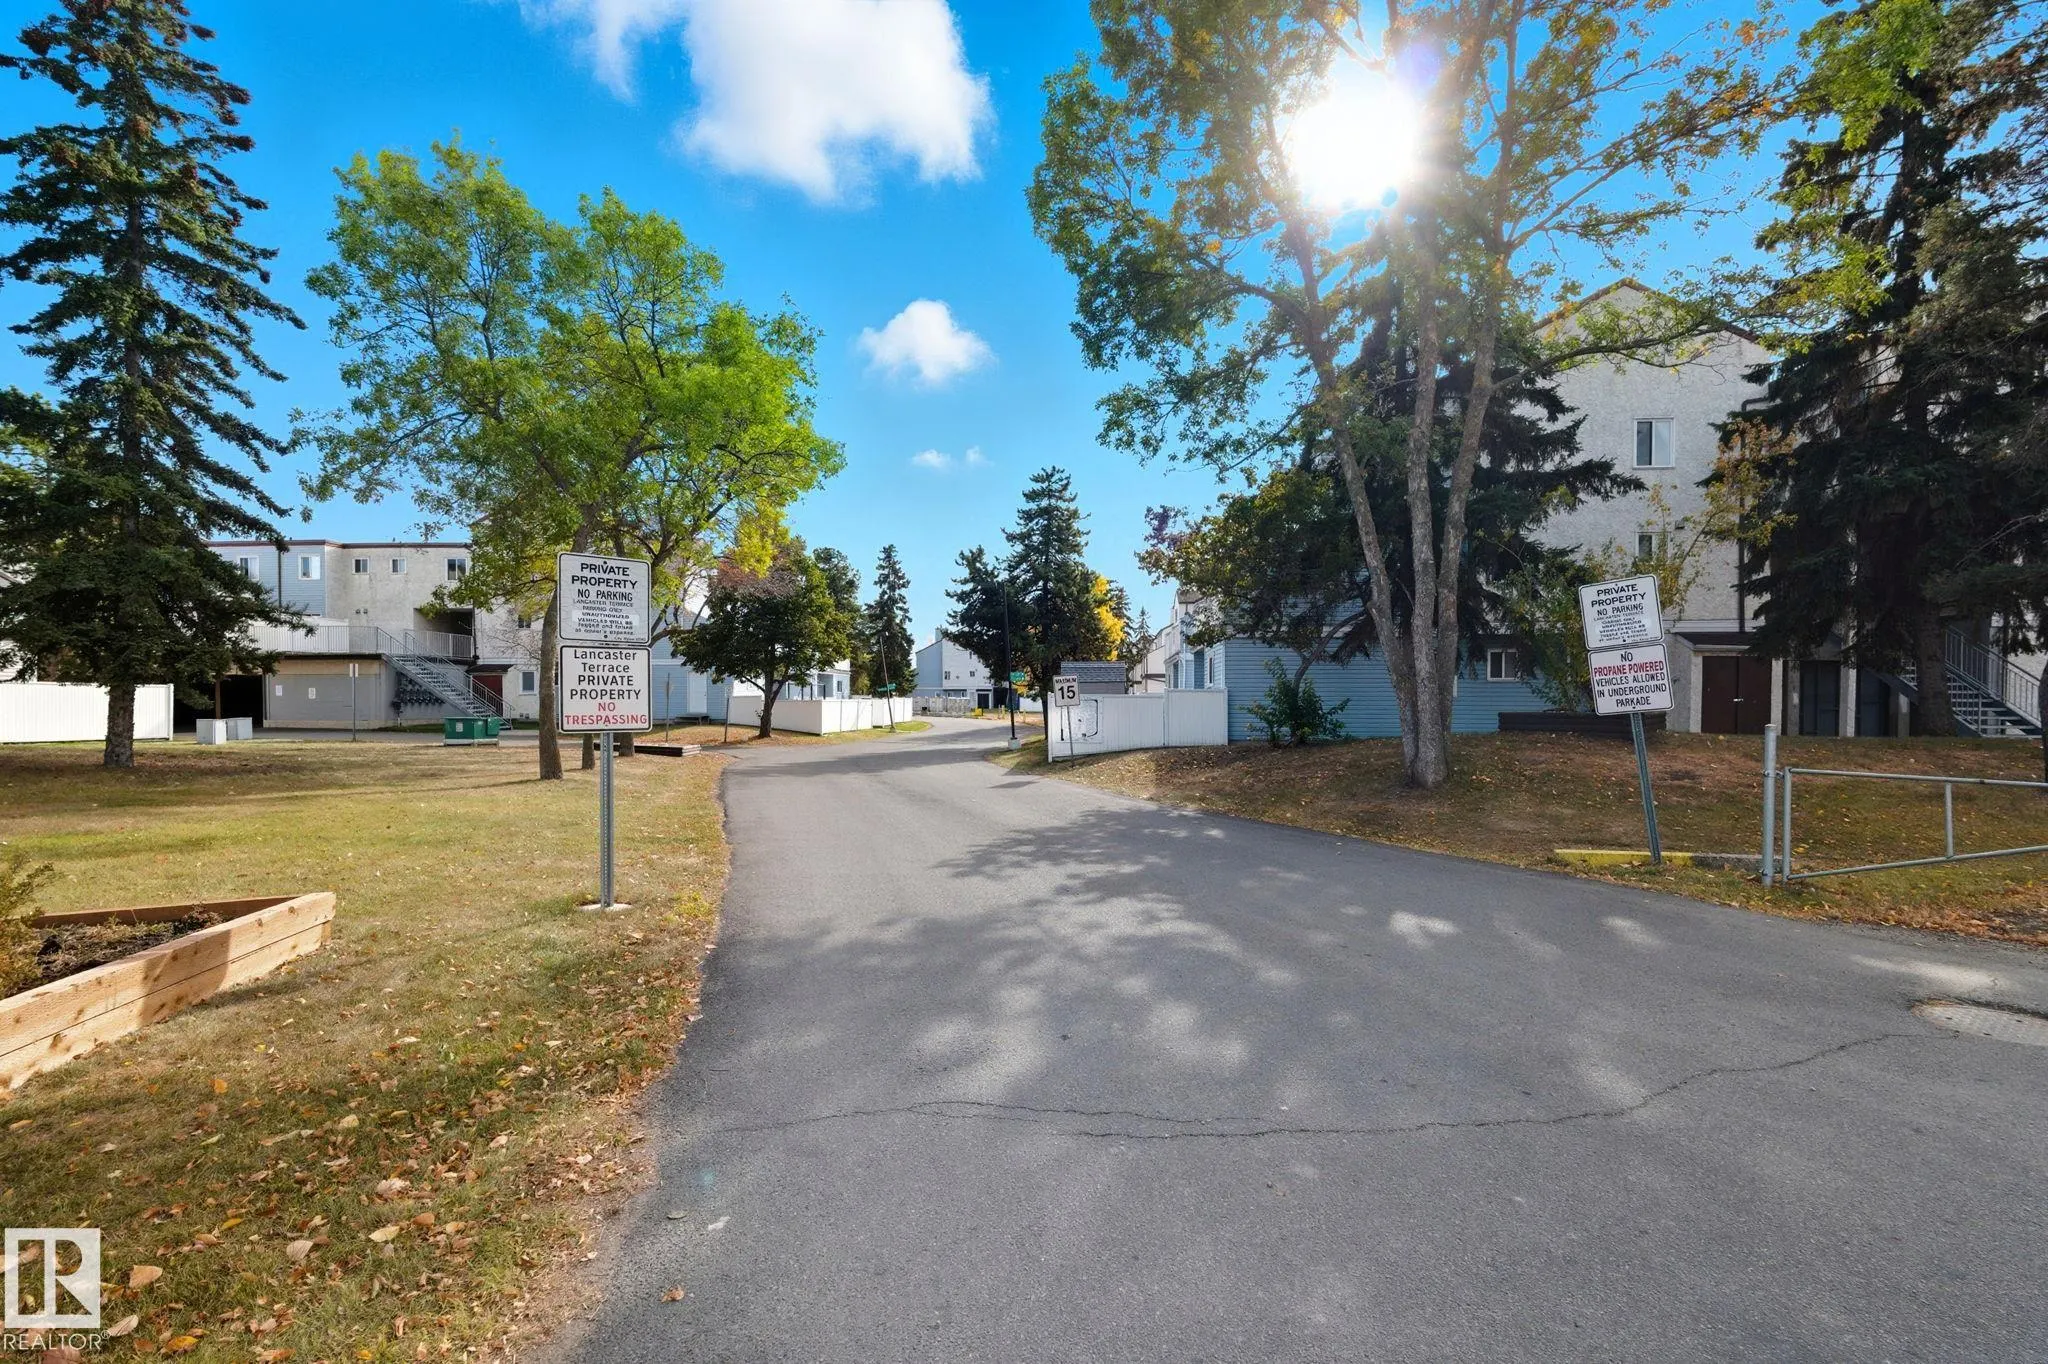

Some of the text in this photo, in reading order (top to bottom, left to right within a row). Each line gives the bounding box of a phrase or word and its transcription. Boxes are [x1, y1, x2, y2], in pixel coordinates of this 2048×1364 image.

[580, 563, 630, 577] PRIVATE
[571, 575, 638, 589] PROPERTY
[577, 588, 633, 602] NO PARKING
[1596, 584, 1639, 597] PRIVATE
[1591, 592, 1647, 608] PROPERTY
[1597, 603, 1644, 617] NO PARKING
[574, 649, 637, 660] Lancaster
[1620, 651, 1634, 662] NO
[581, 662, 630, 673] Terrace
[1593, 660, 1665, 678] PROPANE POWERED
[578, 674, 634, 686] PRIVATE
[1595, 671, 1666, 687] VEHICLES ALLOWED
[570, 688, 641, 700] PROPERTY
[1058, 685, 1076, 700] 15
[1596, 683, 1667, 698] IN UNDERGROUND
[597, 701, 616, 712] NO
[1615, 696, 1652, 708] PARKADE
[564, 714, 648, 725] TRESPASSING
